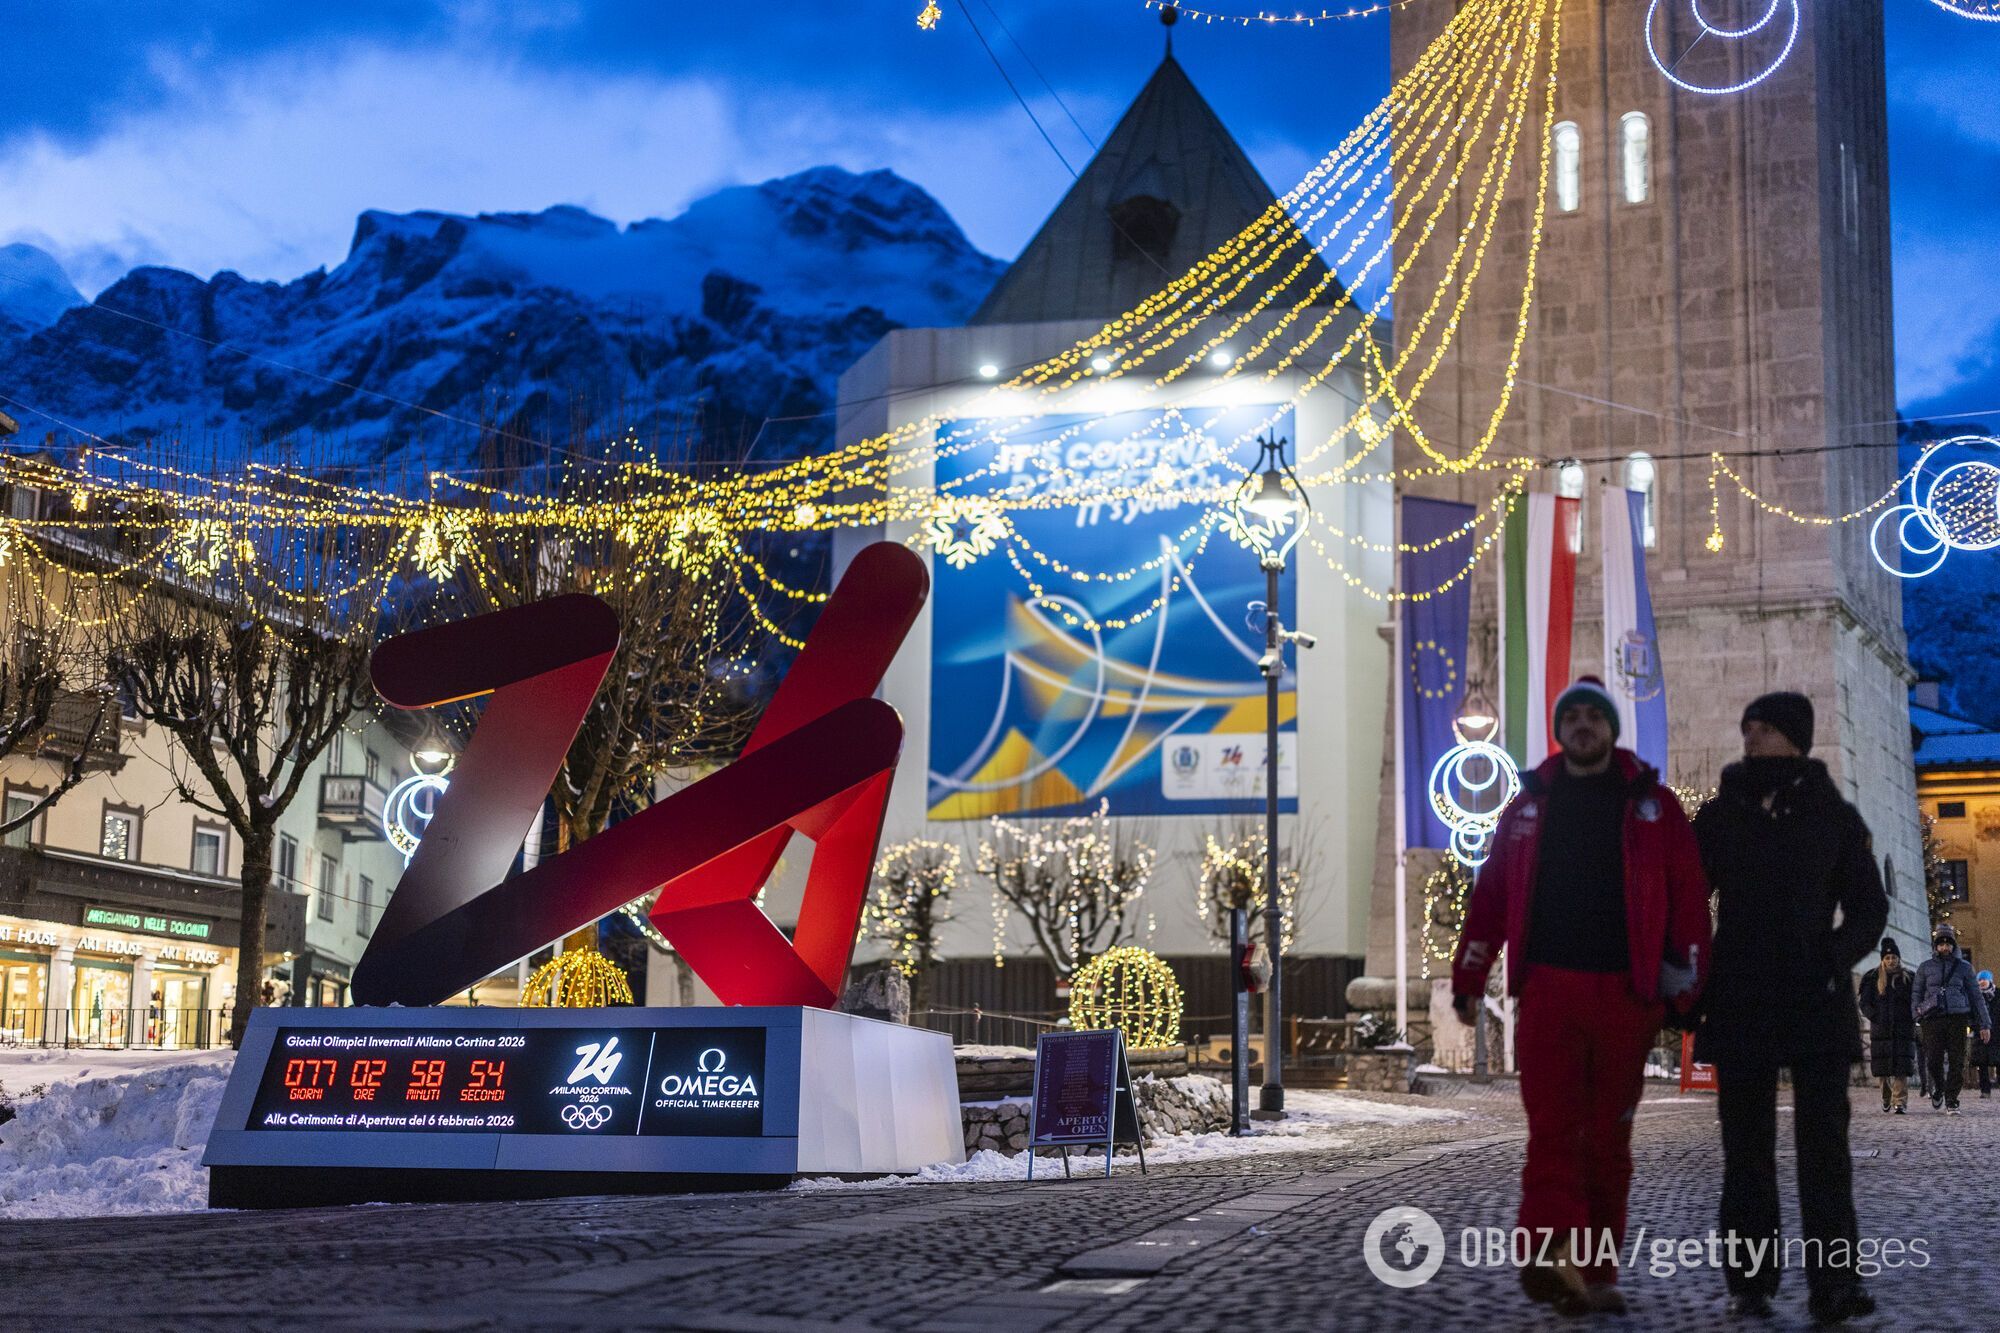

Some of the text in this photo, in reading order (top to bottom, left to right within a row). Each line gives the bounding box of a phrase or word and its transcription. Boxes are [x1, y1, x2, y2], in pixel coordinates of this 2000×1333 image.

[143, 916, 167, 931] NELLE
[17, 928, 57, 946] HOUSE
[78, 936, 143, 956] ART HOUSE
[159, 944, 220, 964] ART HOUSE
[286, 1036, 526, 1050] Giochi Olimpici Invernali Milano Cortina 2026
[284, 1059, 505, 1087] 077 02 58 54
[548, 1086, 632, 1095] MILANO CORTINA
[660, 1075, 758, 1096] OMEGA
[289, 1088, 506, 1101] GIORNI ORE MINUTI SECONDI
[579, 1094, 600, 1103] 2026
[655, 1099, 760, 1109] OFFICIAL TIMEKEEPER
[263, 1113, 515, 1128] Alla Cerimonia di Apertura del 6 febbraio 2026
[1057, 1115, 1107, 1126] APERTO
[1071, 1124, 1106, 1134] OPEN
